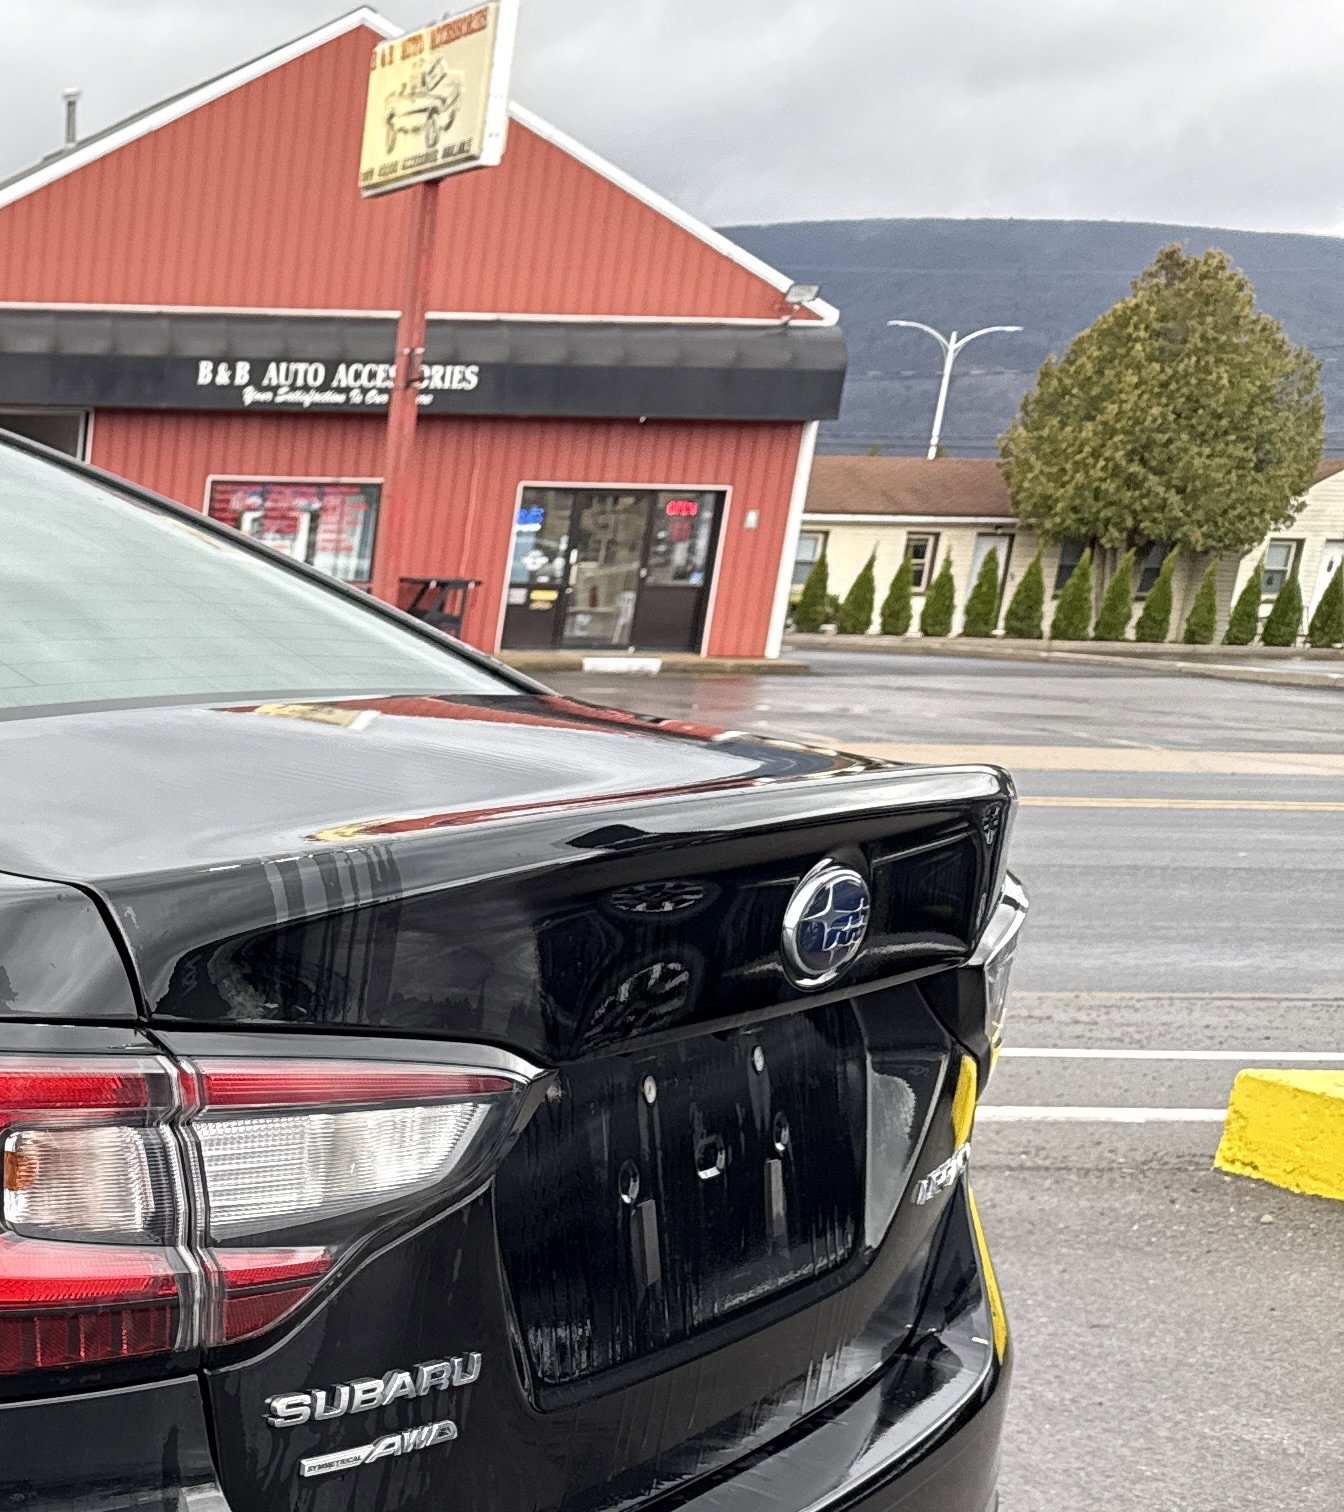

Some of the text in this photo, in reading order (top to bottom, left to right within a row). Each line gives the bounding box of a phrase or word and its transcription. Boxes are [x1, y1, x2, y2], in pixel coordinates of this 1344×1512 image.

[197, 360, 214, 386] B
[215, 362, 232, 386] &
[234, 361, 251, 386] B
[261, 362, 326, 387] AUTO
[265, 1352, 482, 1428] SUBARU
[364, 1420, 458, 1464] AWD
